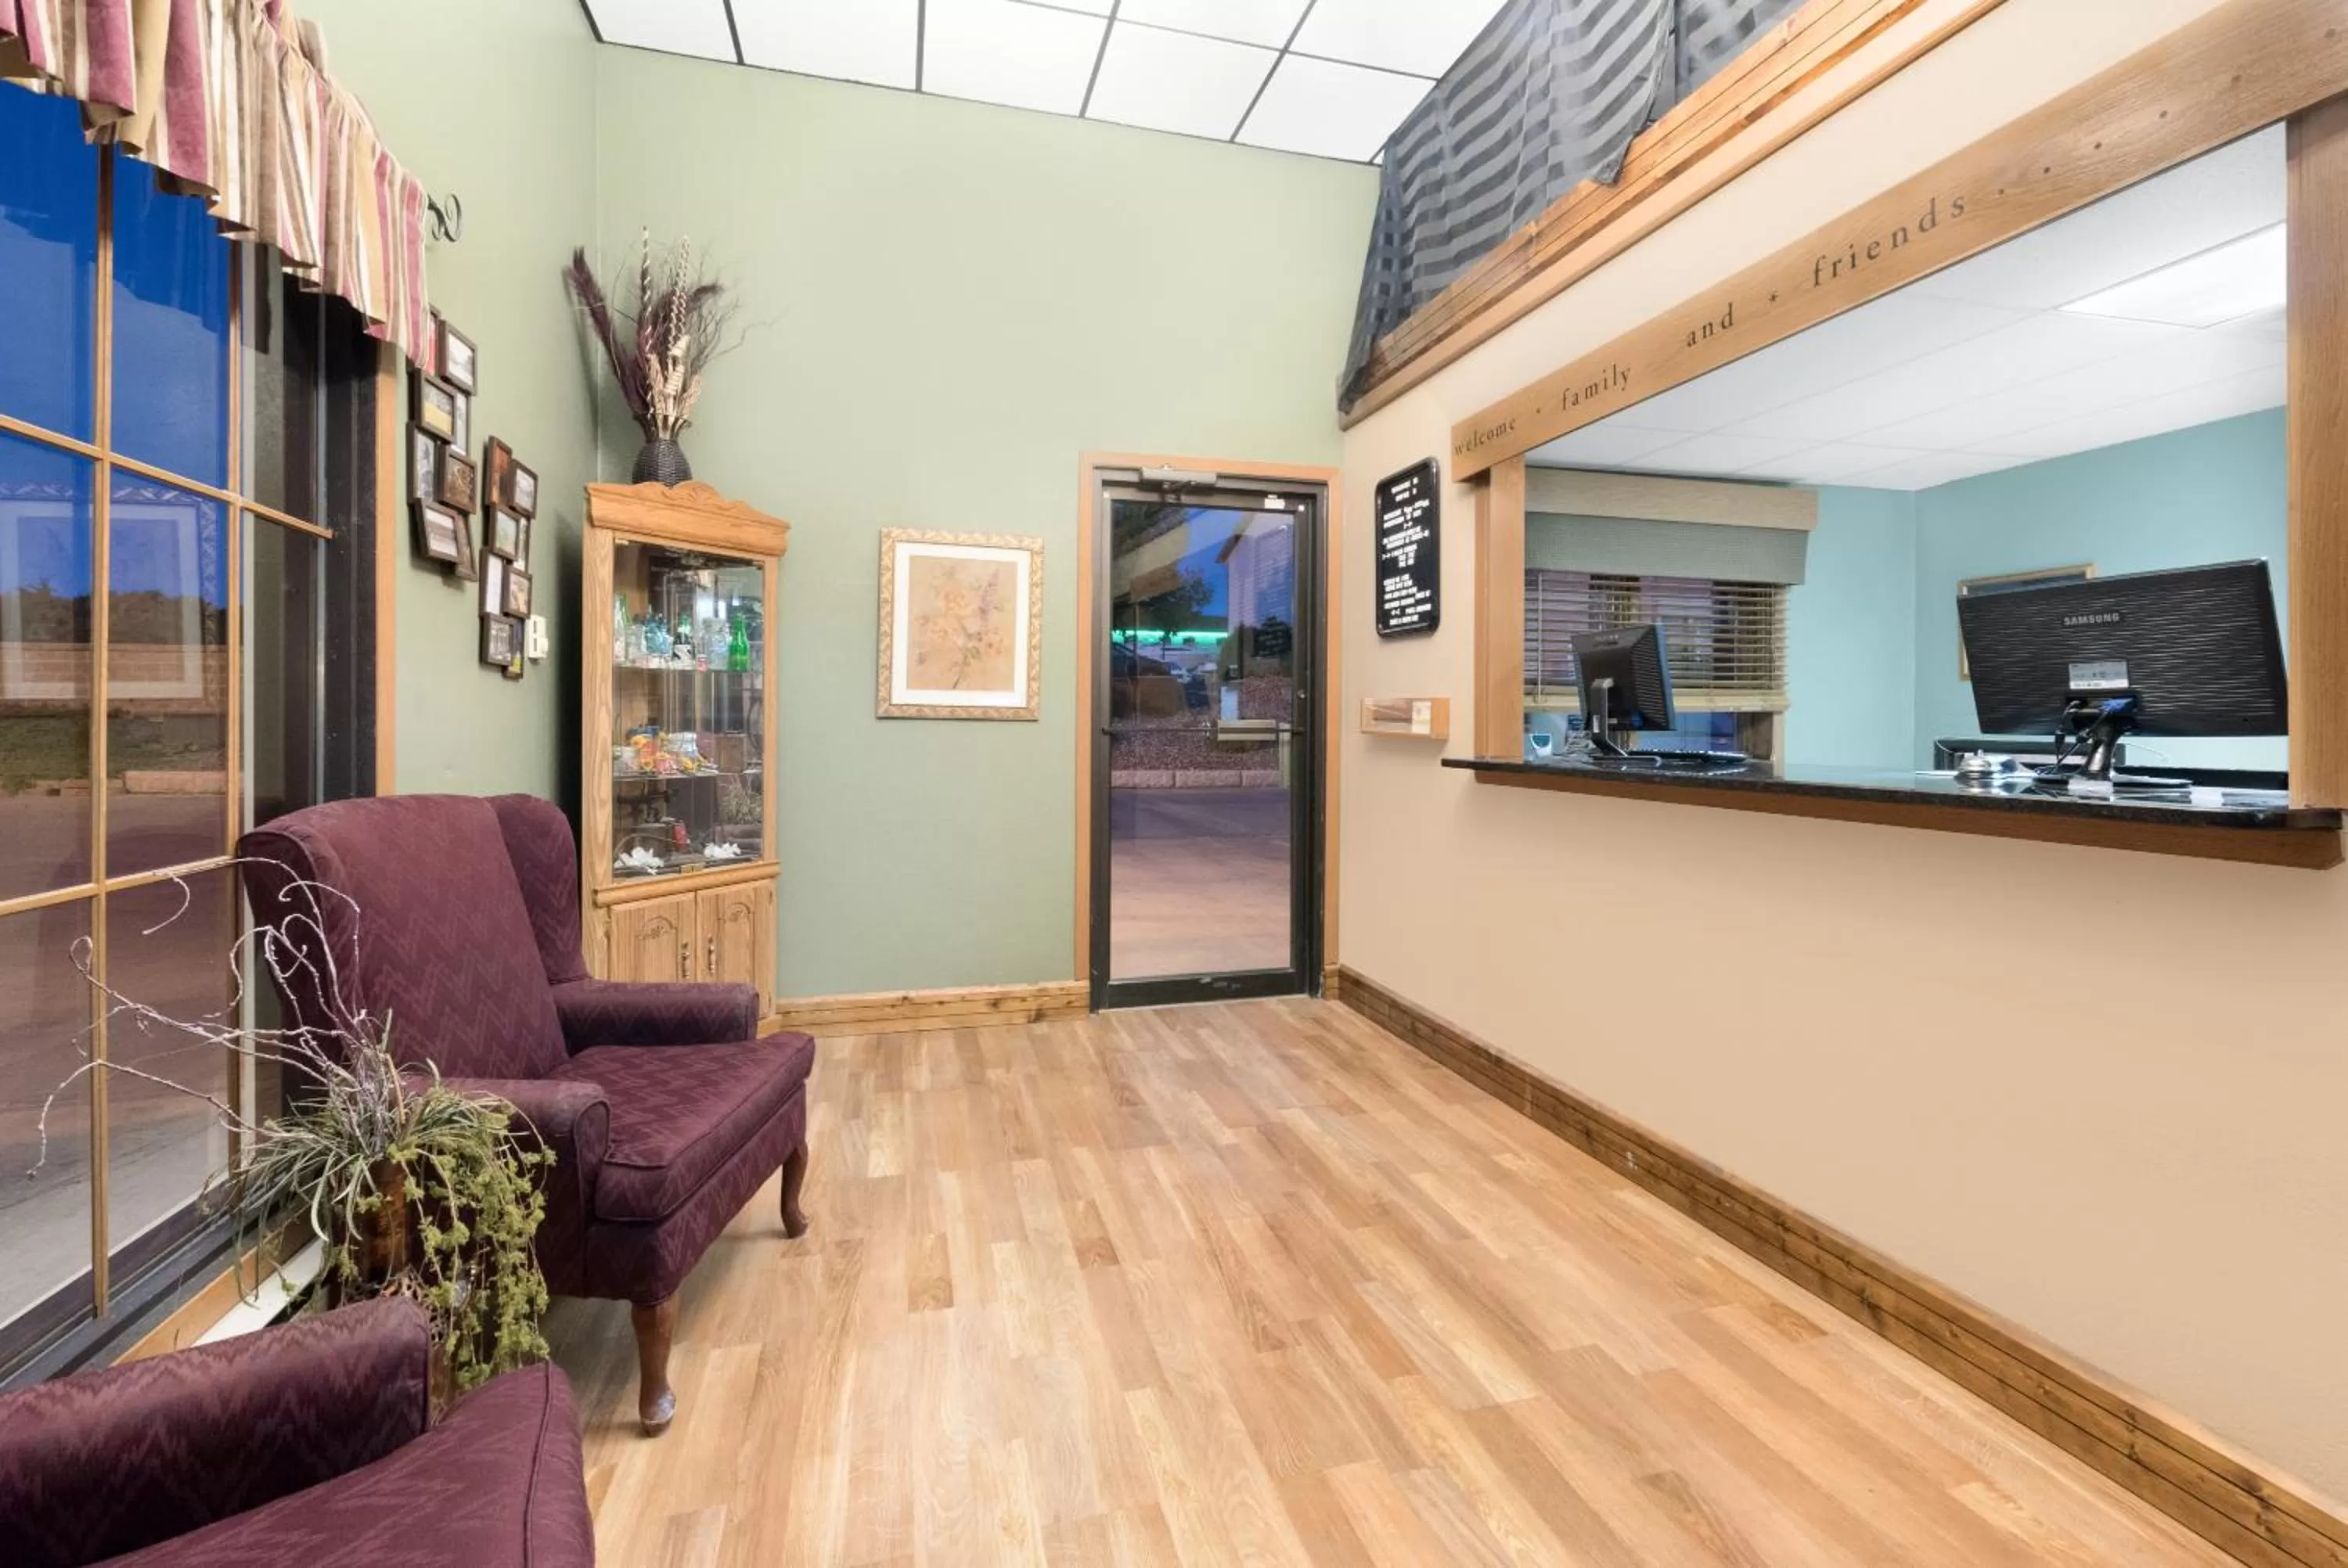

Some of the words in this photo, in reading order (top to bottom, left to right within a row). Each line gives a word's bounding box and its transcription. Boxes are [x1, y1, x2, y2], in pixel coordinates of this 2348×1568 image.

[1453, 417, 1516, 455] welcome
[1561, 363, 1631, 411] family
[1686, 301, 1734, 347] and
[1813, 196, 1965, 288] friends
[2062, 613, 2120, 625] SAMSUNG
